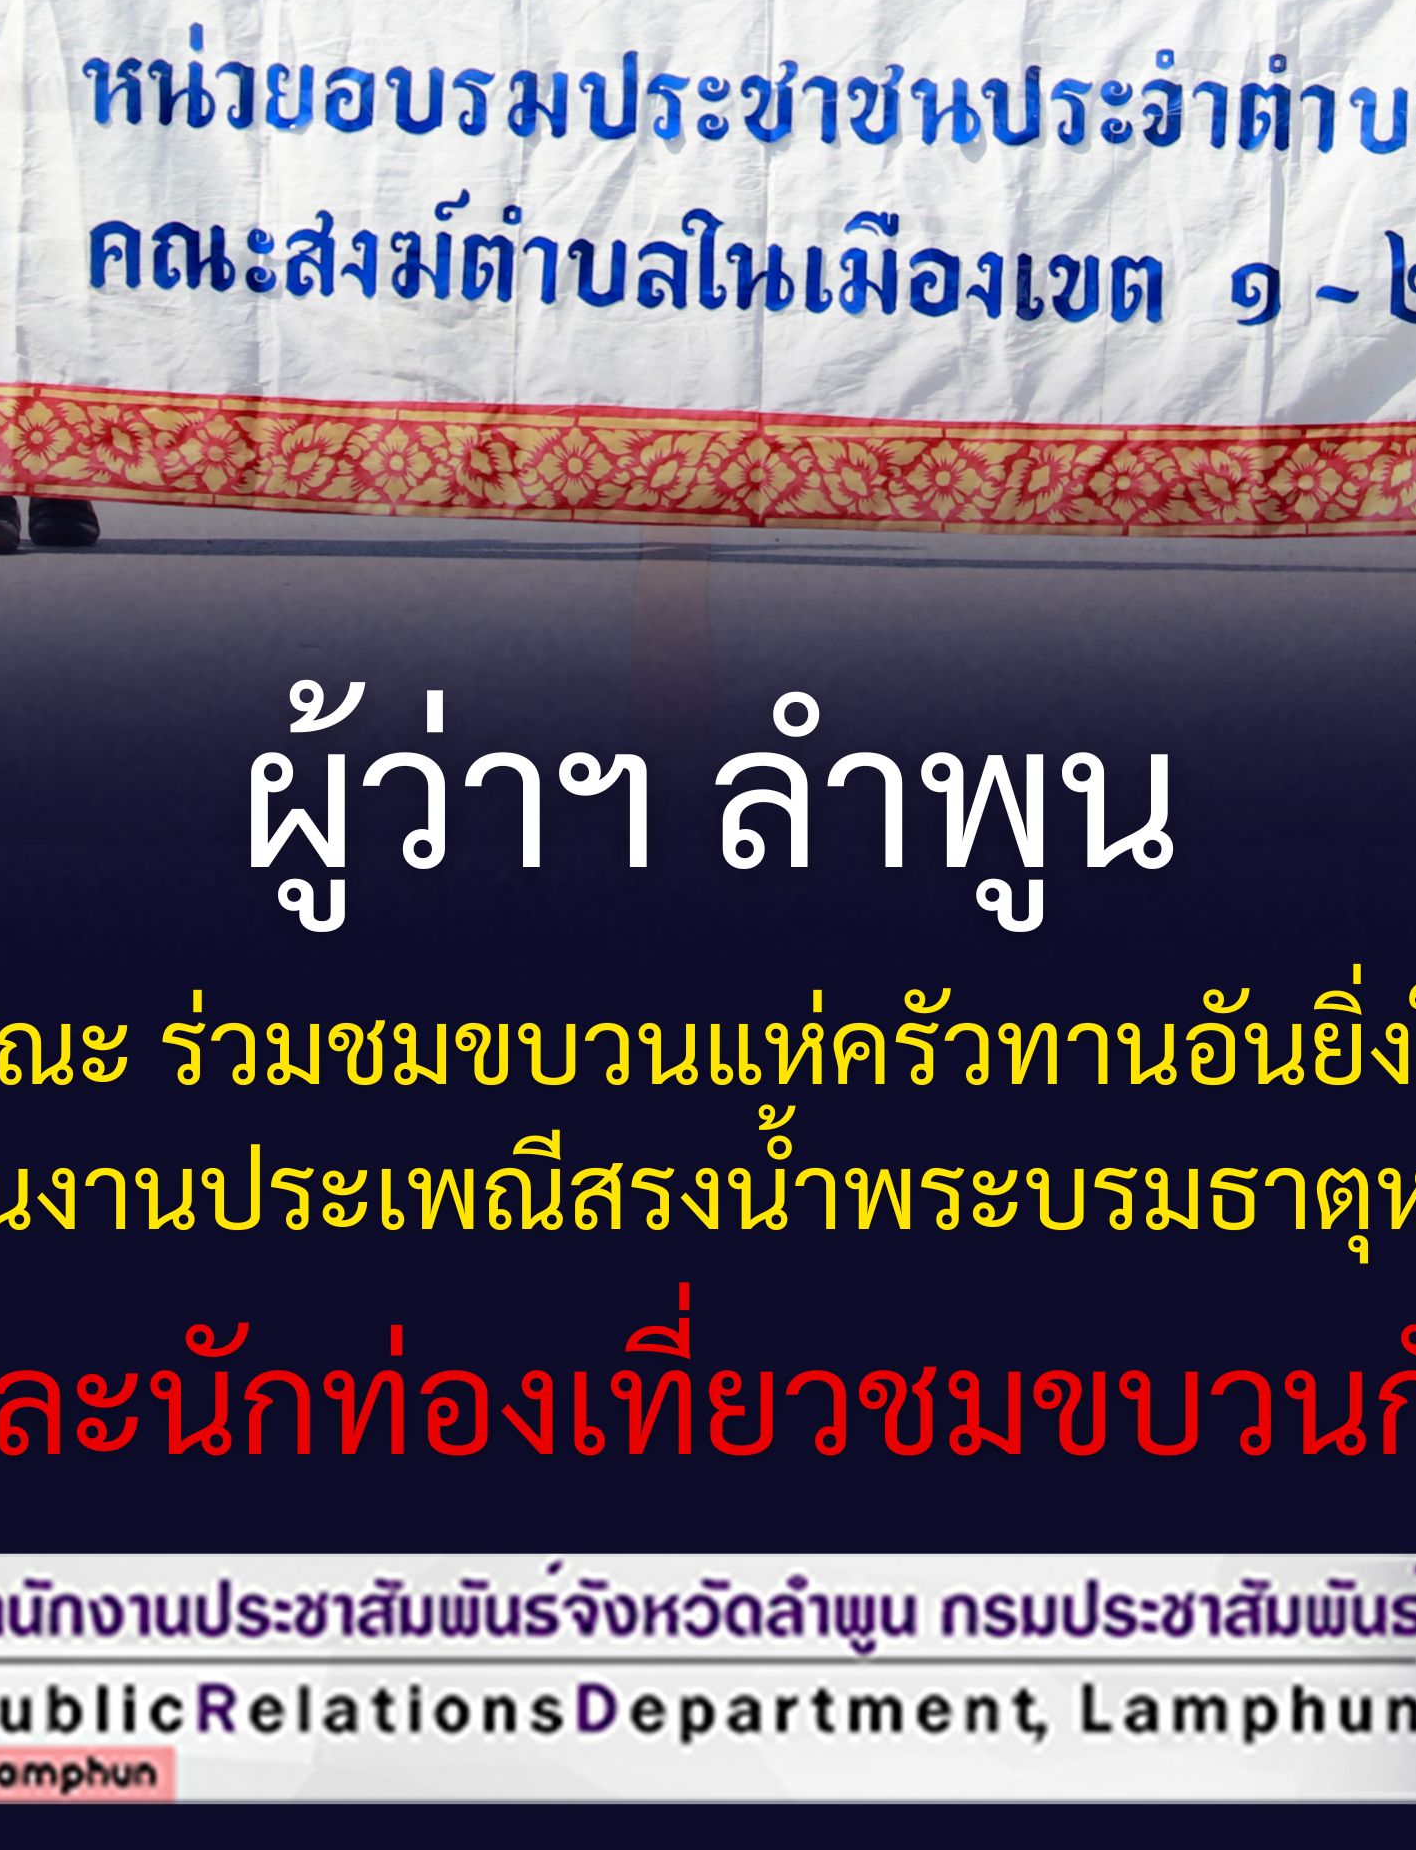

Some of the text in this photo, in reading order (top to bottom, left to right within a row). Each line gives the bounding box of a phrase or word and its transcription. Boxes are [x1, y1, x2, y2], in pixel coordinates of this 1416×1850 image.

[89, 188, 1164, 325] คณะสงฆ์ตำบลในเมืองเขต
[1230, 261, 1283, 328] ๑
